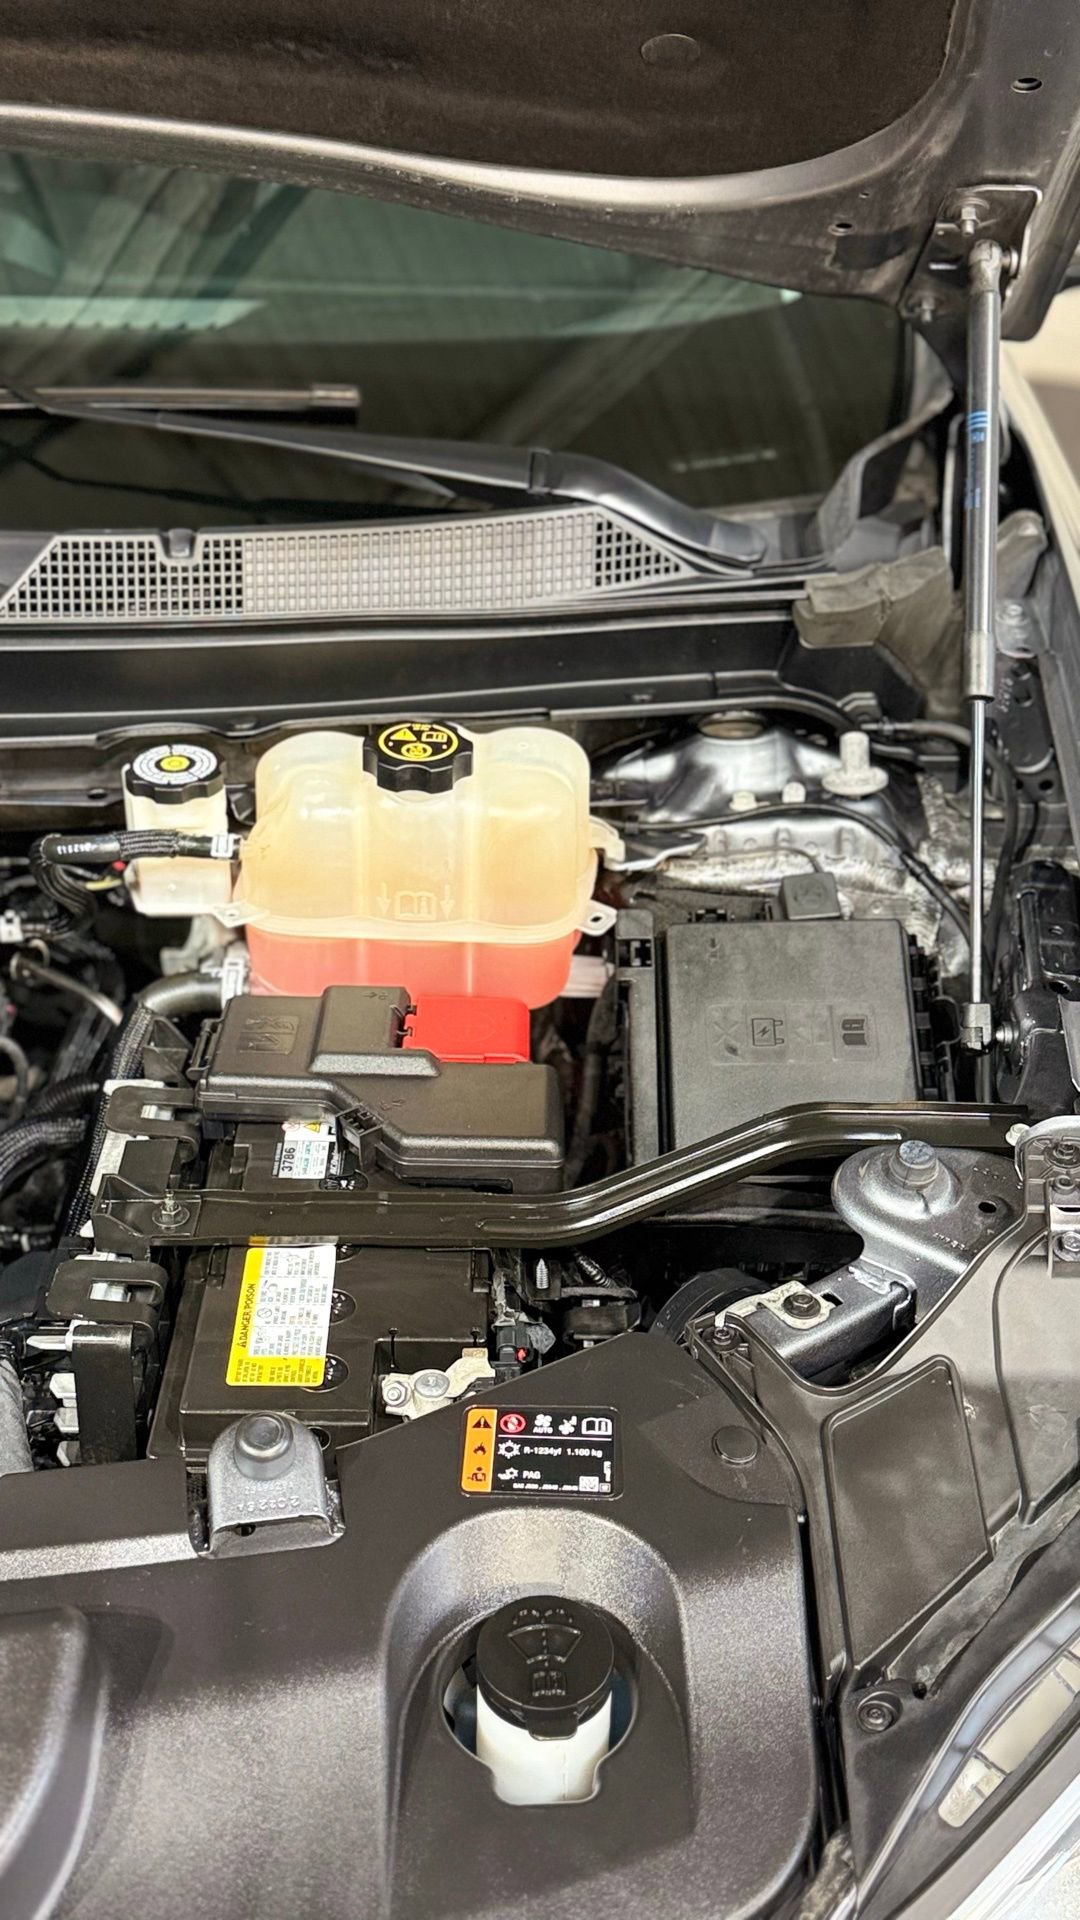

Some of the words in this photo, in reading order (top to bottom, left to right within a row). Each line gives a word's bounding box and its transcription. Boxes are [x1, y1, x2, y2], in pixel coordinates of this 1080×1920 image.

[282, 1147, 296, 1172] 3786
[244, 1283, 256, 1310] POISON
[239, 1310, 251, 1338] DANGER
[533, 1426, 553, 1434] AUTO
[523, 1446, 562, 1457] R-1234yf
[566, 1448, 590, 1457] 1.100
[591, 1449, 603, 1458] kg
[522, 1470, 541, 1480] PAG
